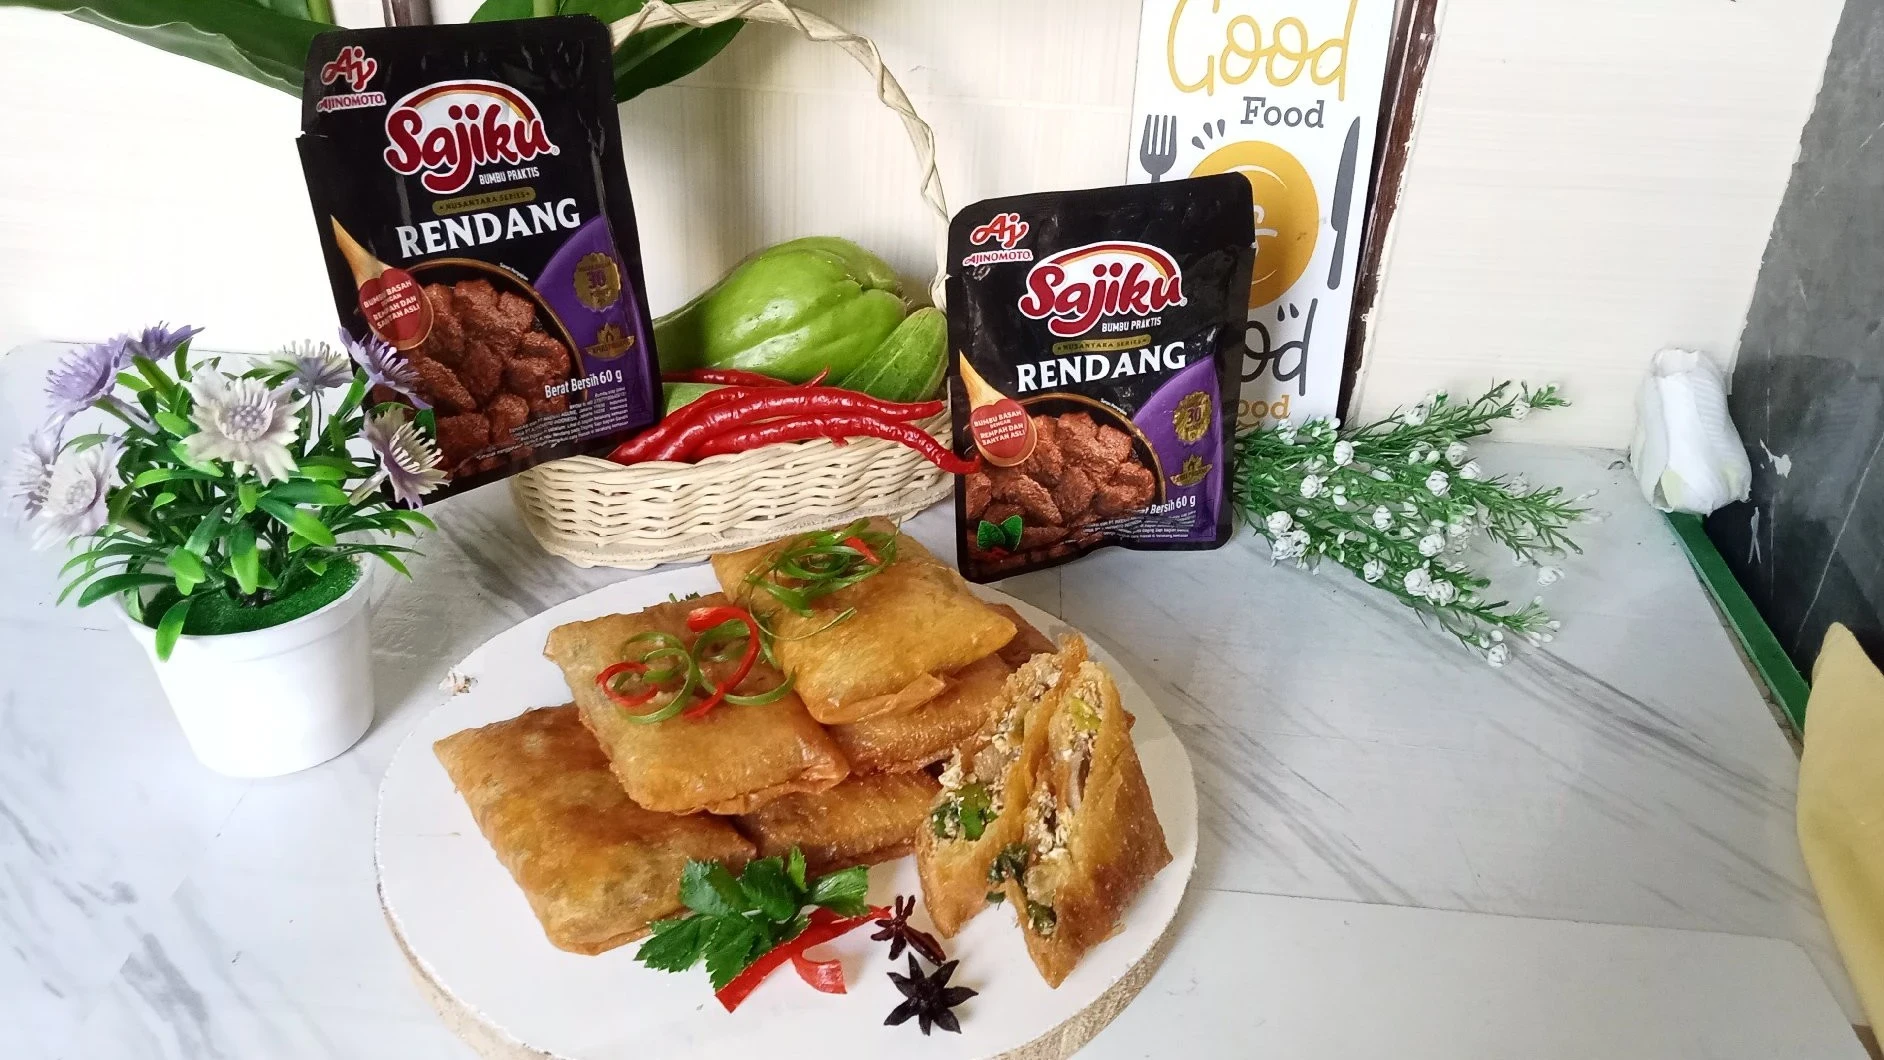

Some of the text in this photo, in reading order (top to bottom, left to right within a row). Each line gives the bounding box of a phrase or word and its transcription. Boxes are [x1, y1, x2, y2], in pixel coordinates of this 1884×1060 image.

[1167, 0, 1358, 101] Good
[1240, 96, 1325, 128] Food
[384, 103, 554, 194] Sajiku
[479, 166, 540, 185] BUMBU PRAKTIS
[445, 191, 526, 210] NUSANTARA SERIES
[395, 198, 581, 259] RENDANG
[386, 280, 412, 296] BASAH
[400, 295, 417, 308] DAN
[404, 303, 420, 315] ASLI
[1018, 261, 1183, 338] Sajiku
[1102, 317, 1162, 333] BUMBU PRAKTIS
[1062, 339, 1141, 351] NUSANTARA SERIES
[1240, 298, 1318, 397] od
[1017, 341, 1186, 393] RENDANG
[545, 369, 623, 399] Berat Bersih 60 g
[1238, 395, 1290, 420] ood
[973, 410, 1022, 427] BUMBU BASAH
[980, 422, 1024, 439] REMPAH DAN
[982, 430, 1026, 446] SANTAN ASLI
[1150, 500, 1175, 514] Bersih
[1176, 495, 1188, 509] 60
[1189, 495, 1196, 508] g
